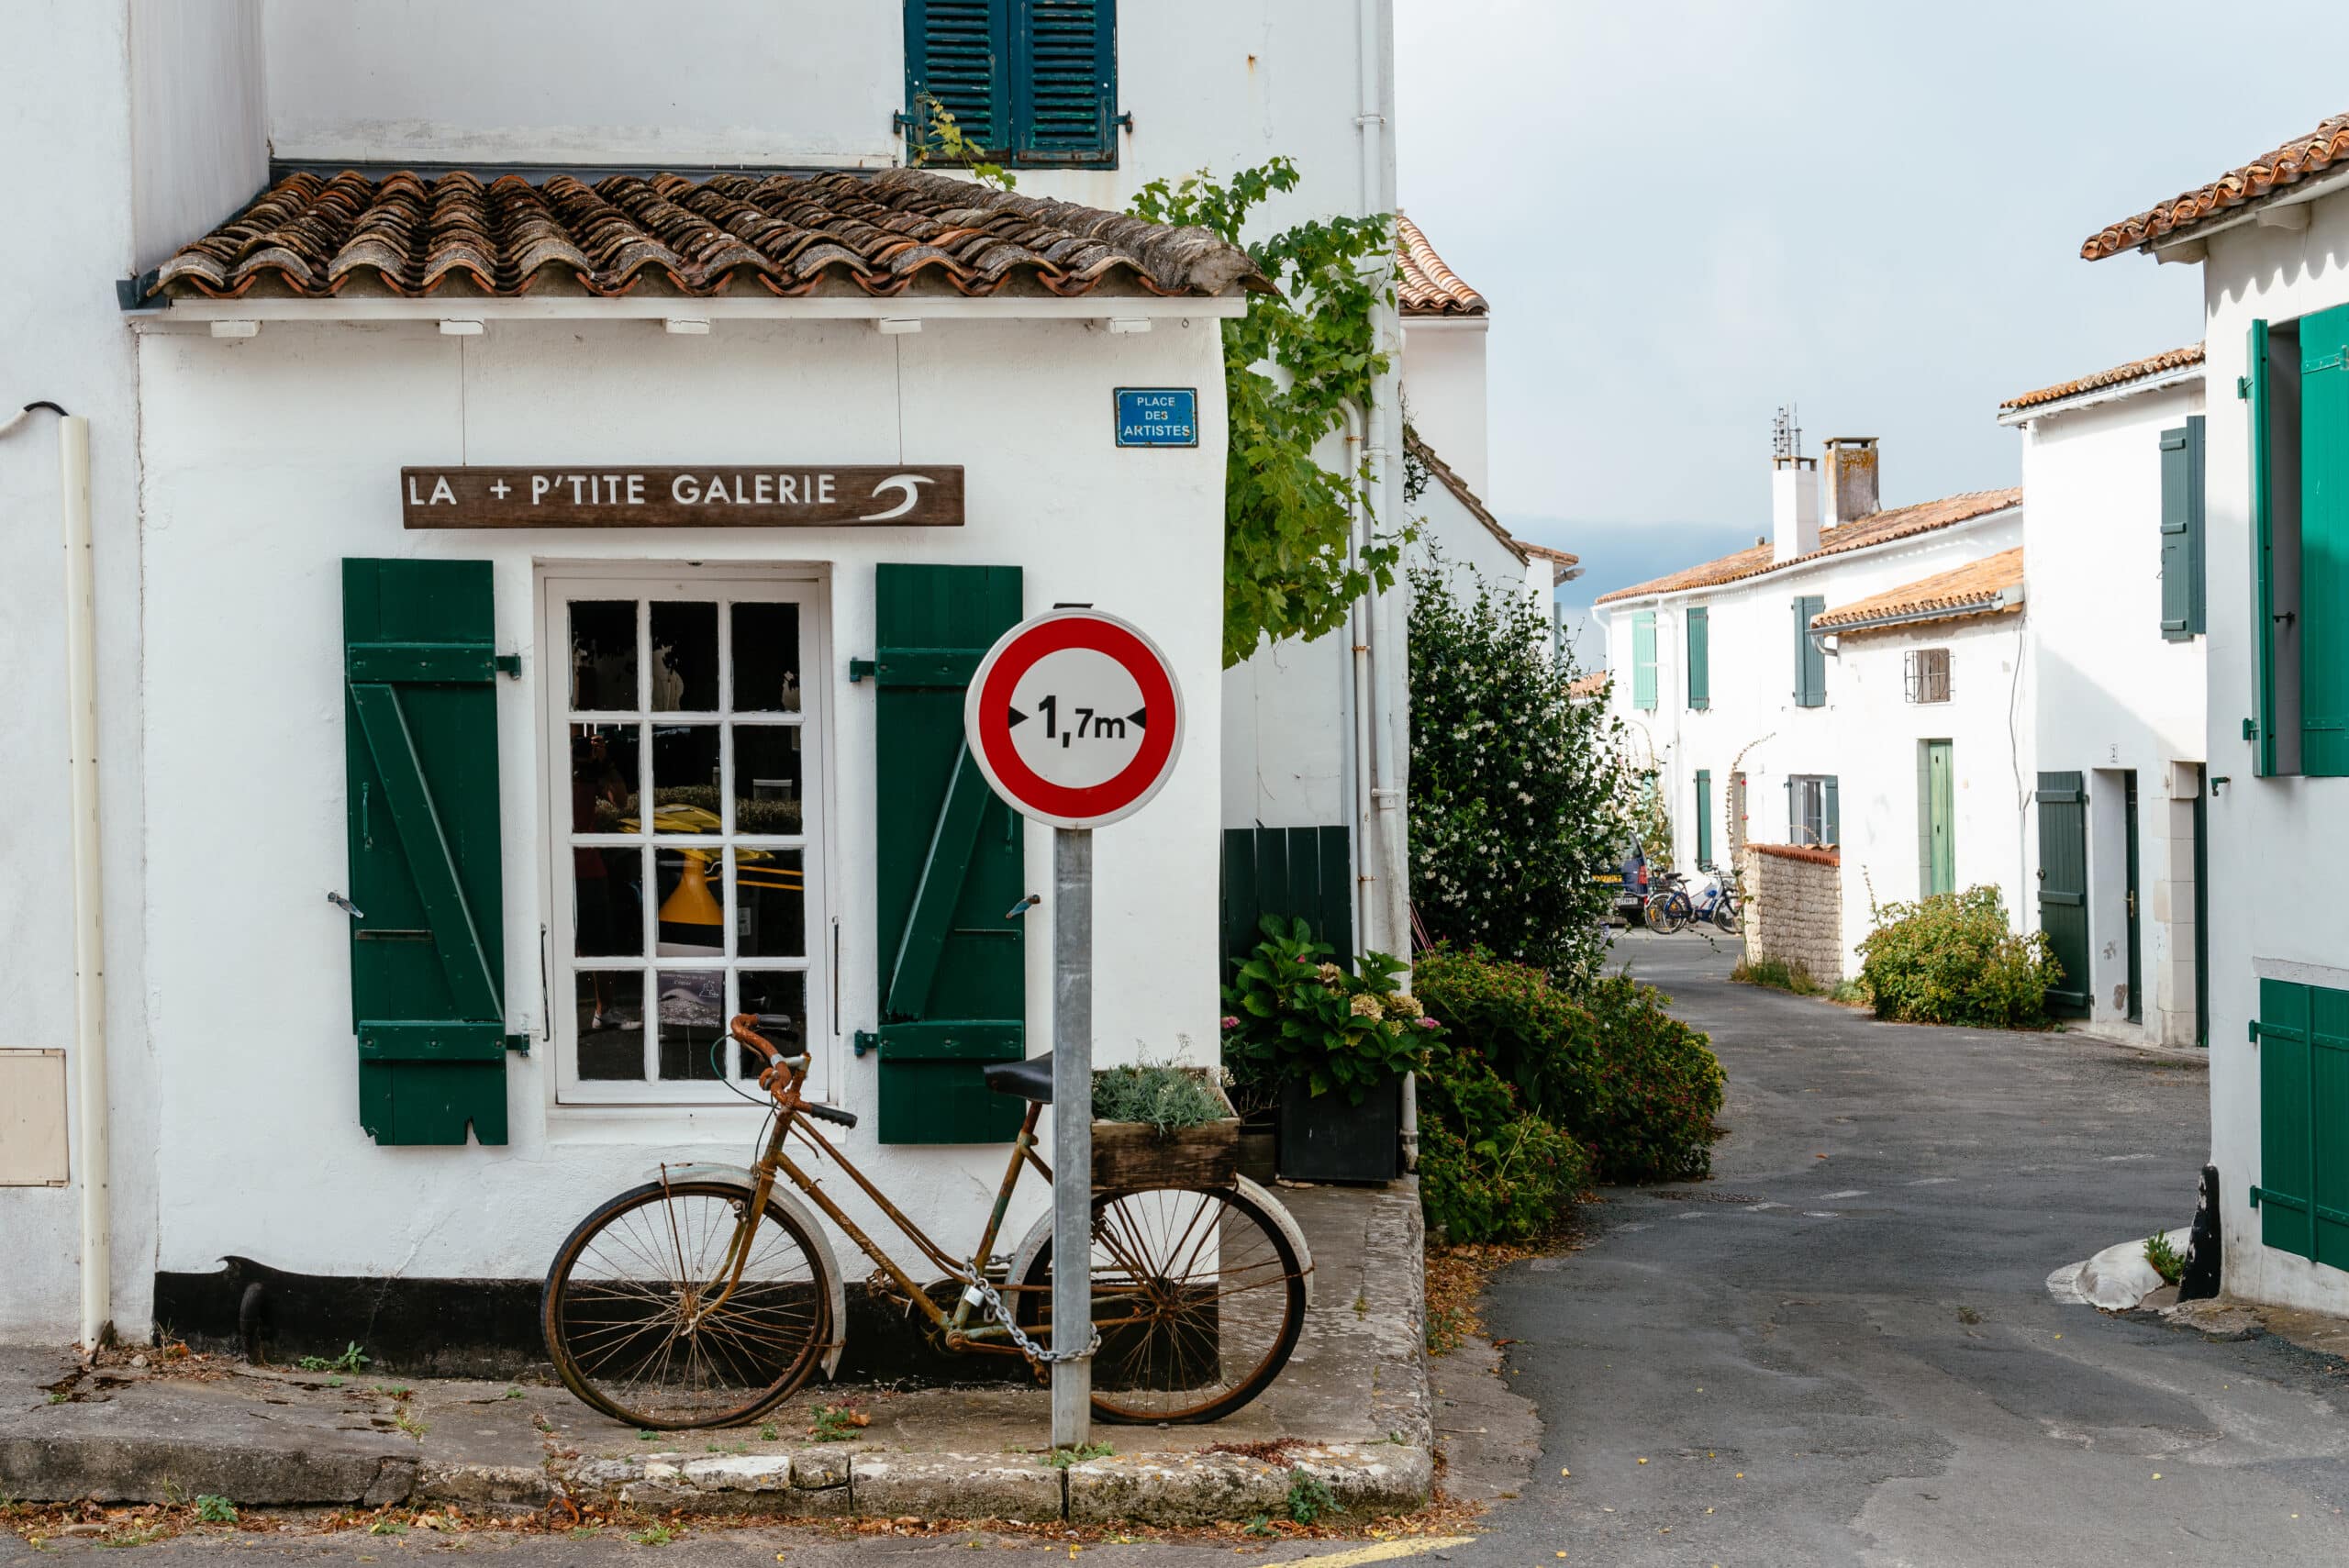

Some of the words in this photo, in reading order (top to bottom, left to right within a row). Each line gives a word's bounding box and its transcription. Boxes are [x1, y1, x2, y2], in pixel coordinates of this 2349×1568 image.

[1137, 396, 1175, 406] PLACE
[1145, 410, 1168, 420] DES
[1123, 425, 1190, 437] ARTISTES
[409, 475, 457, 505] LA
[532, 474, 645, 505] P'TITE
[672, 474, 836, 505] GALERIE
[1038, 695, 1126, 749] 1,7m
